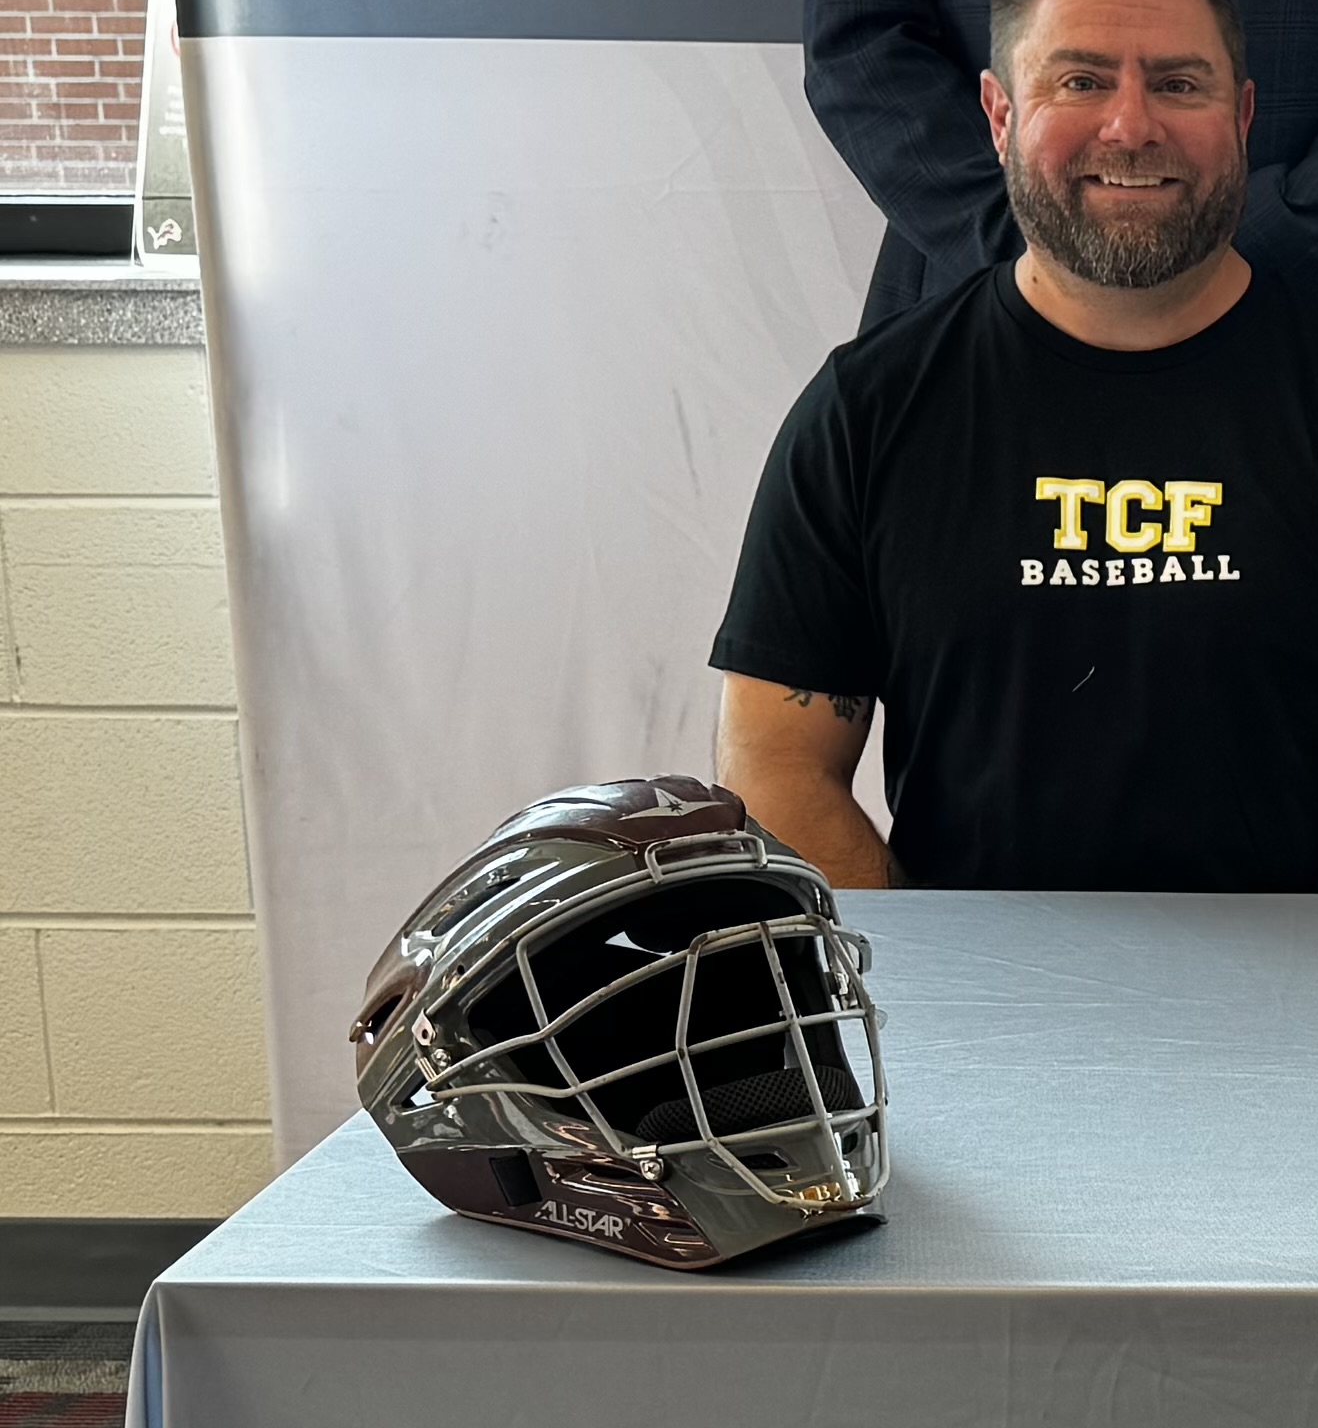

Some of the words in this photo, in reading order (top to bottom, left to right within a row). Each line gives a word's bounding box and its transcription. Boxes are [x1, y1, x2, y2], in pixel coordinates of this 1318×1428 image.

[1035, 476, 1223, 553] TCF
[1020, 554, 1241, 587] BASEBALL
[535, 1200, 624, 1240] ALL-STAR
